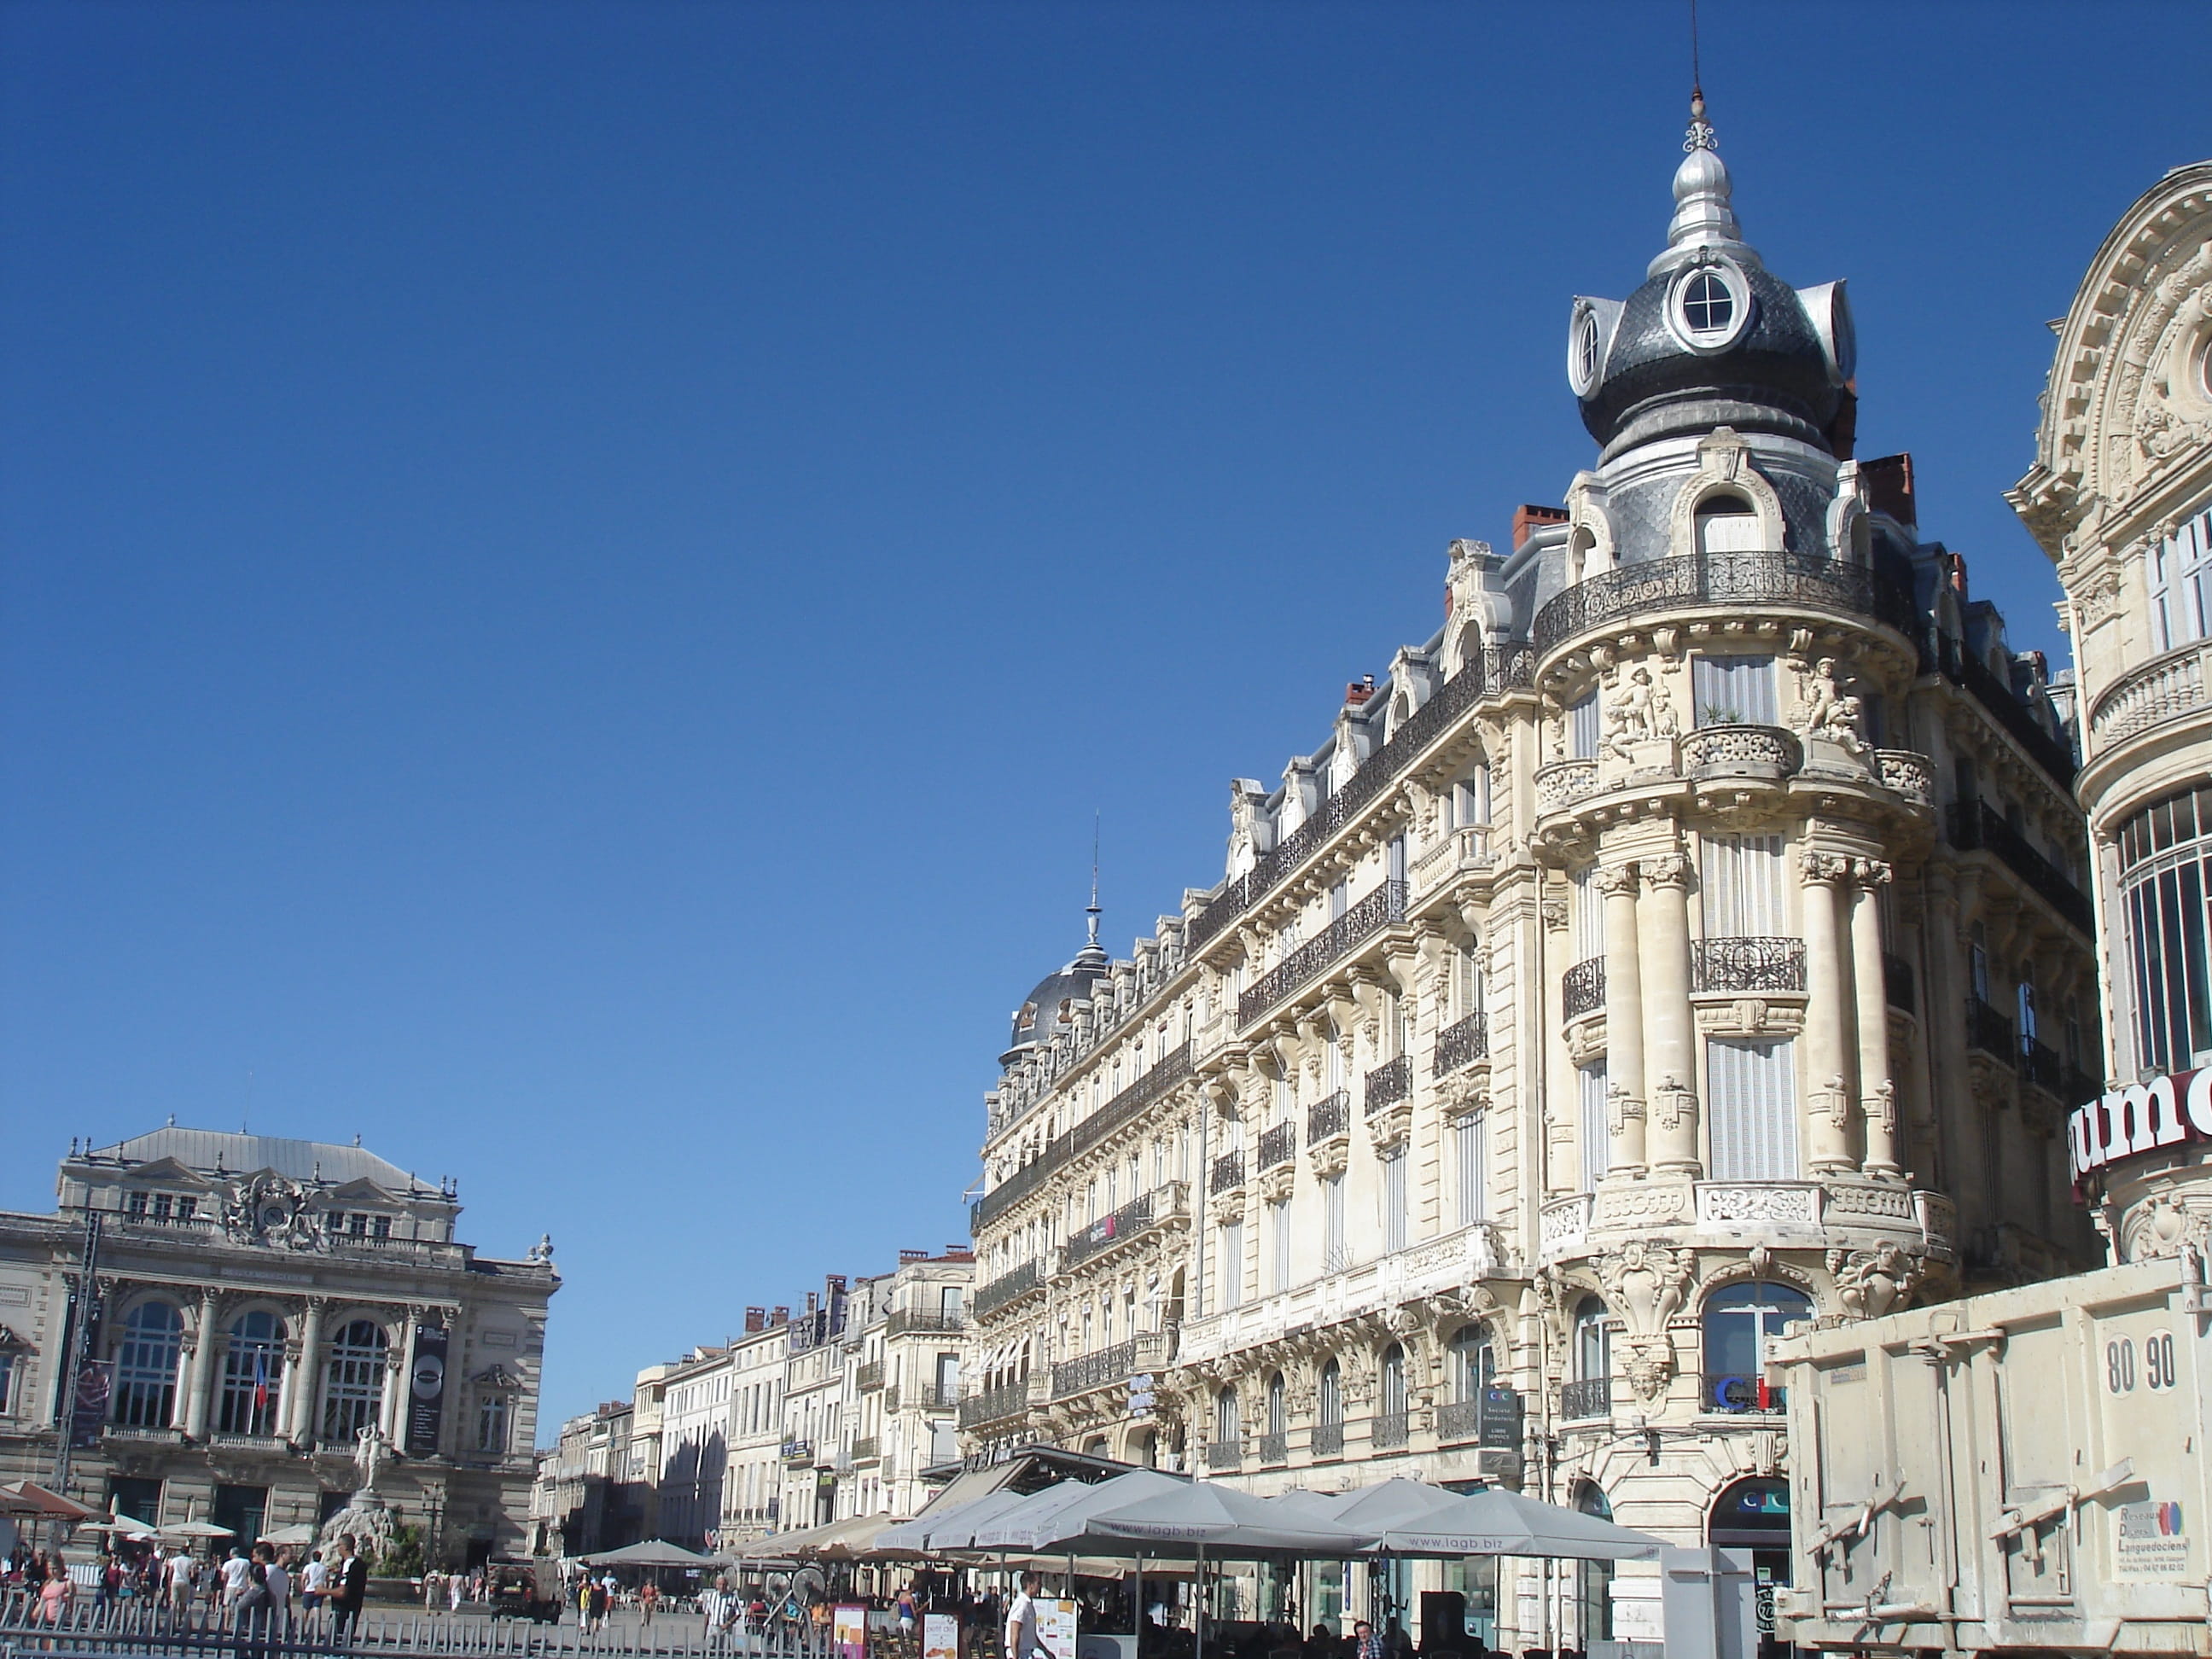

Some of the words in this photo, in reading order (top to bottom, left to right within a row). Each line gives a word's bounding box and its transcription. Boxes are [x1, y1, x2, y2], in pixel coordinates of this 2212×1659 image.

[2106, 1341, 2134, 1394] 80
[2146, 1333, 2175, 1389] 90
[1490, 1392, 1509, 1400] CIC
[1715, 1376, 1787, 1410] CI
[1110, 1522, 1207, 1538] www.lagb.biz
[1409, 1537, 1503, 1550] www.lagb.biz
[2118, 1539, 2187, 1554] Languedociens
